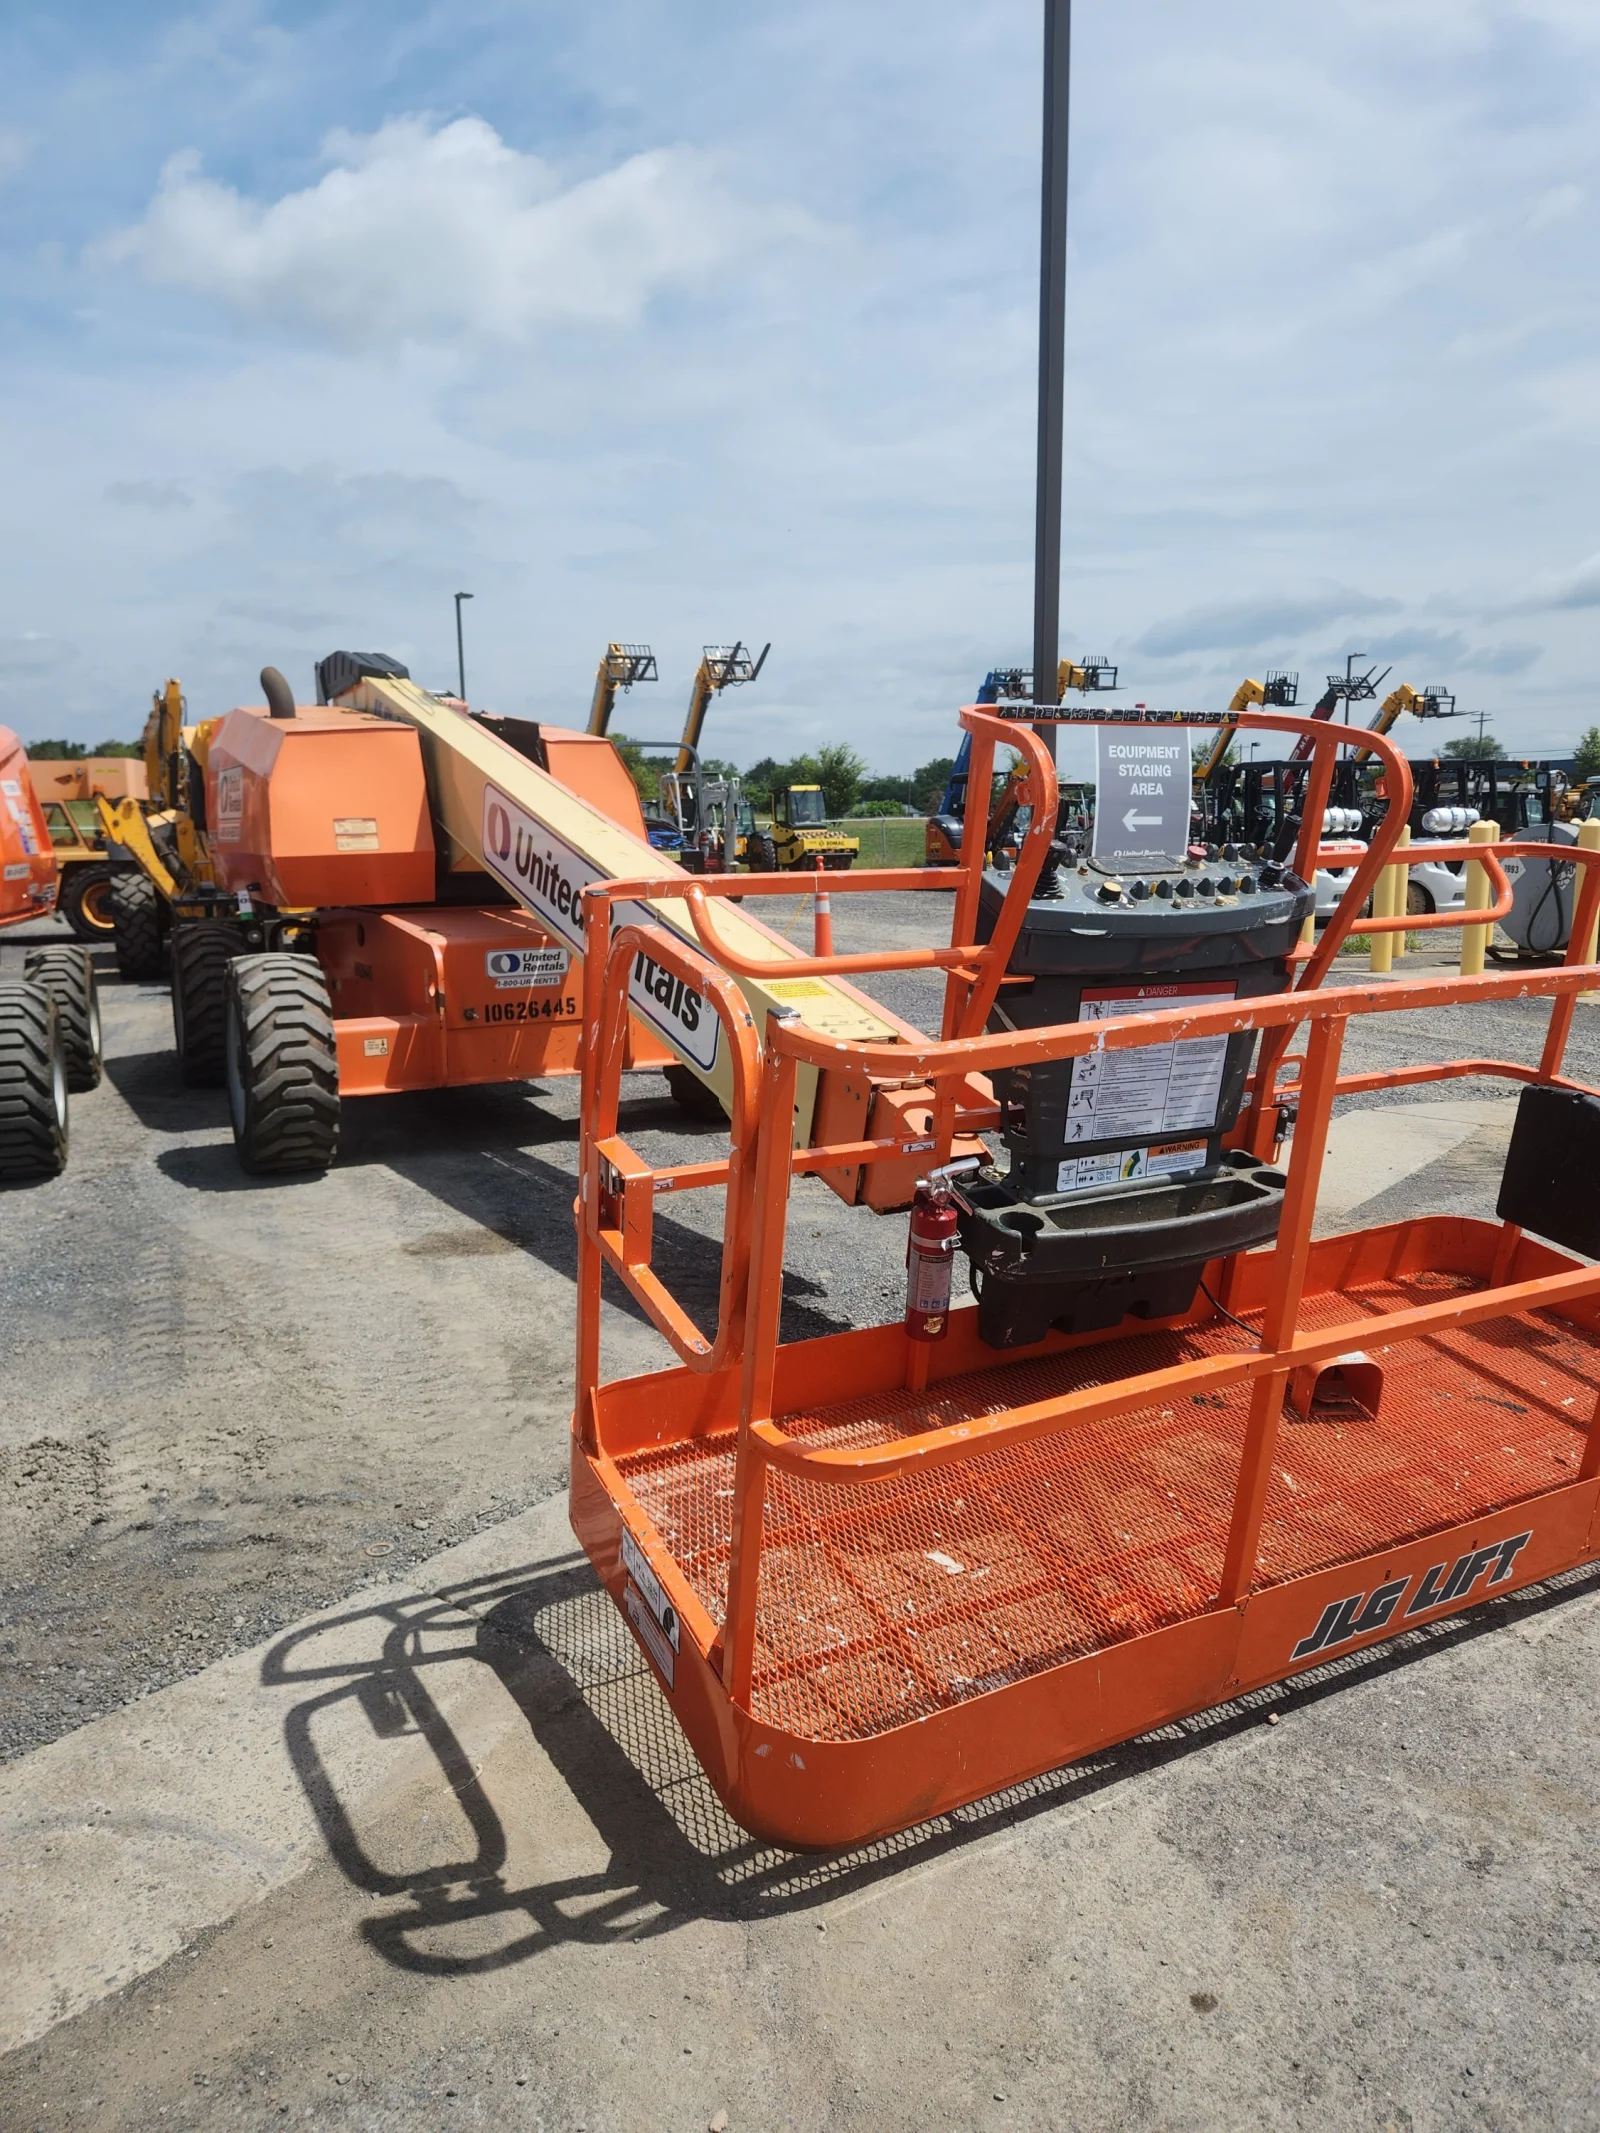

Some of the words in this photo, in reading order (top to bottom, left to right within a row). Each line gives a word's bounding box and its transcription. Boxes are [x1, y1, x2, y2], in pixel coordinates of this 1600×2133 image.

[1108, 745, 1180, 759] EQUIPMENT
[1118, 764, 1172, 777] STAGING
[1130, 783, 1164, 795] AREA
[522, 952, 561, 963] United
[522, 961, 565, 973] Rentals
[1146, 985, 1178, 997] DANGER
[484, 997, 576, 1023] 10626445
[1164, 1141, 1200, 1154] WARNING
[1289, 1574, 1413, 1662] JLG
[1403, 1529, 1534, 1619] LIFT
